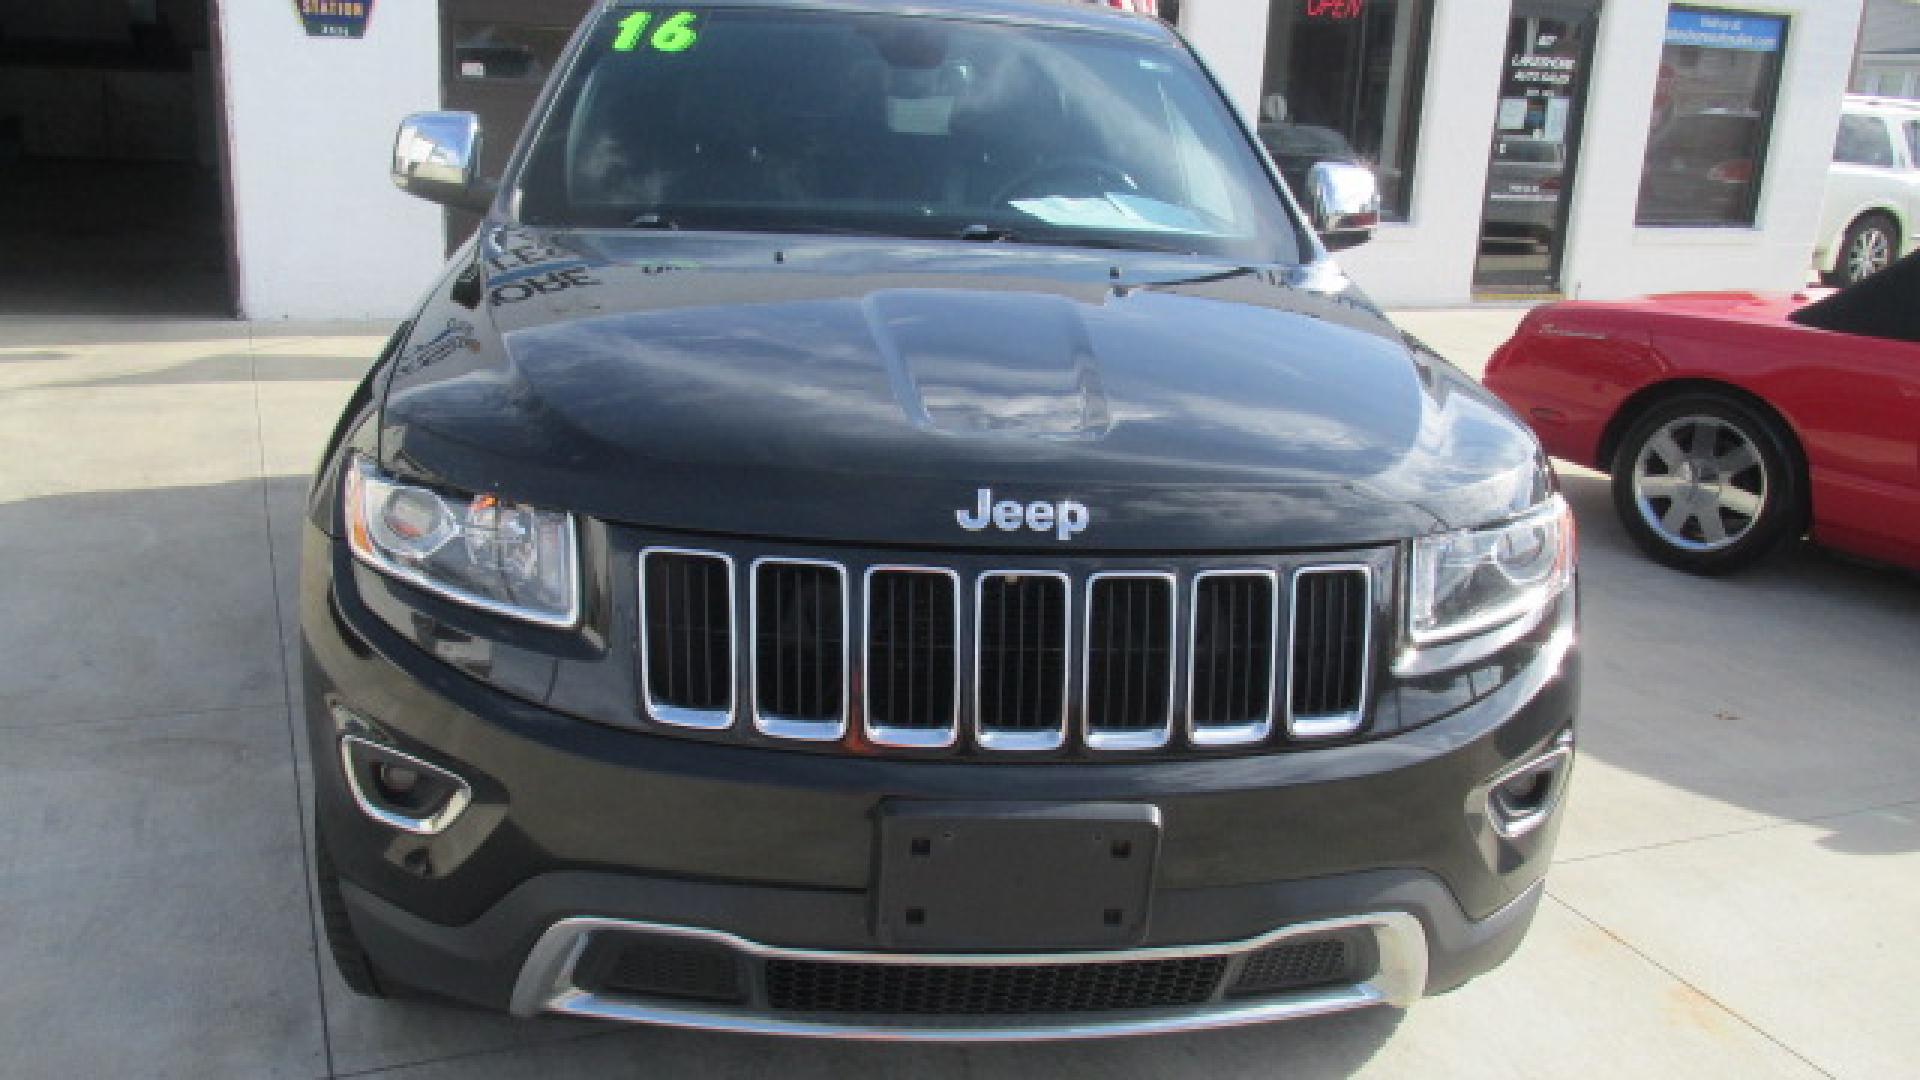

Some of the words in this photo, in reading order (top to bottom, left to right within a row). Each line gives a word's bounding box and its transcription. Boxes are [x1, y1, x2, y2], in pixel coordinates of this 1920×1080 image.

[1307, 0, 1362, 18] OPEN
[613, 11, 697, 52] 16
[954, 488, 1090, 541] Jeep
